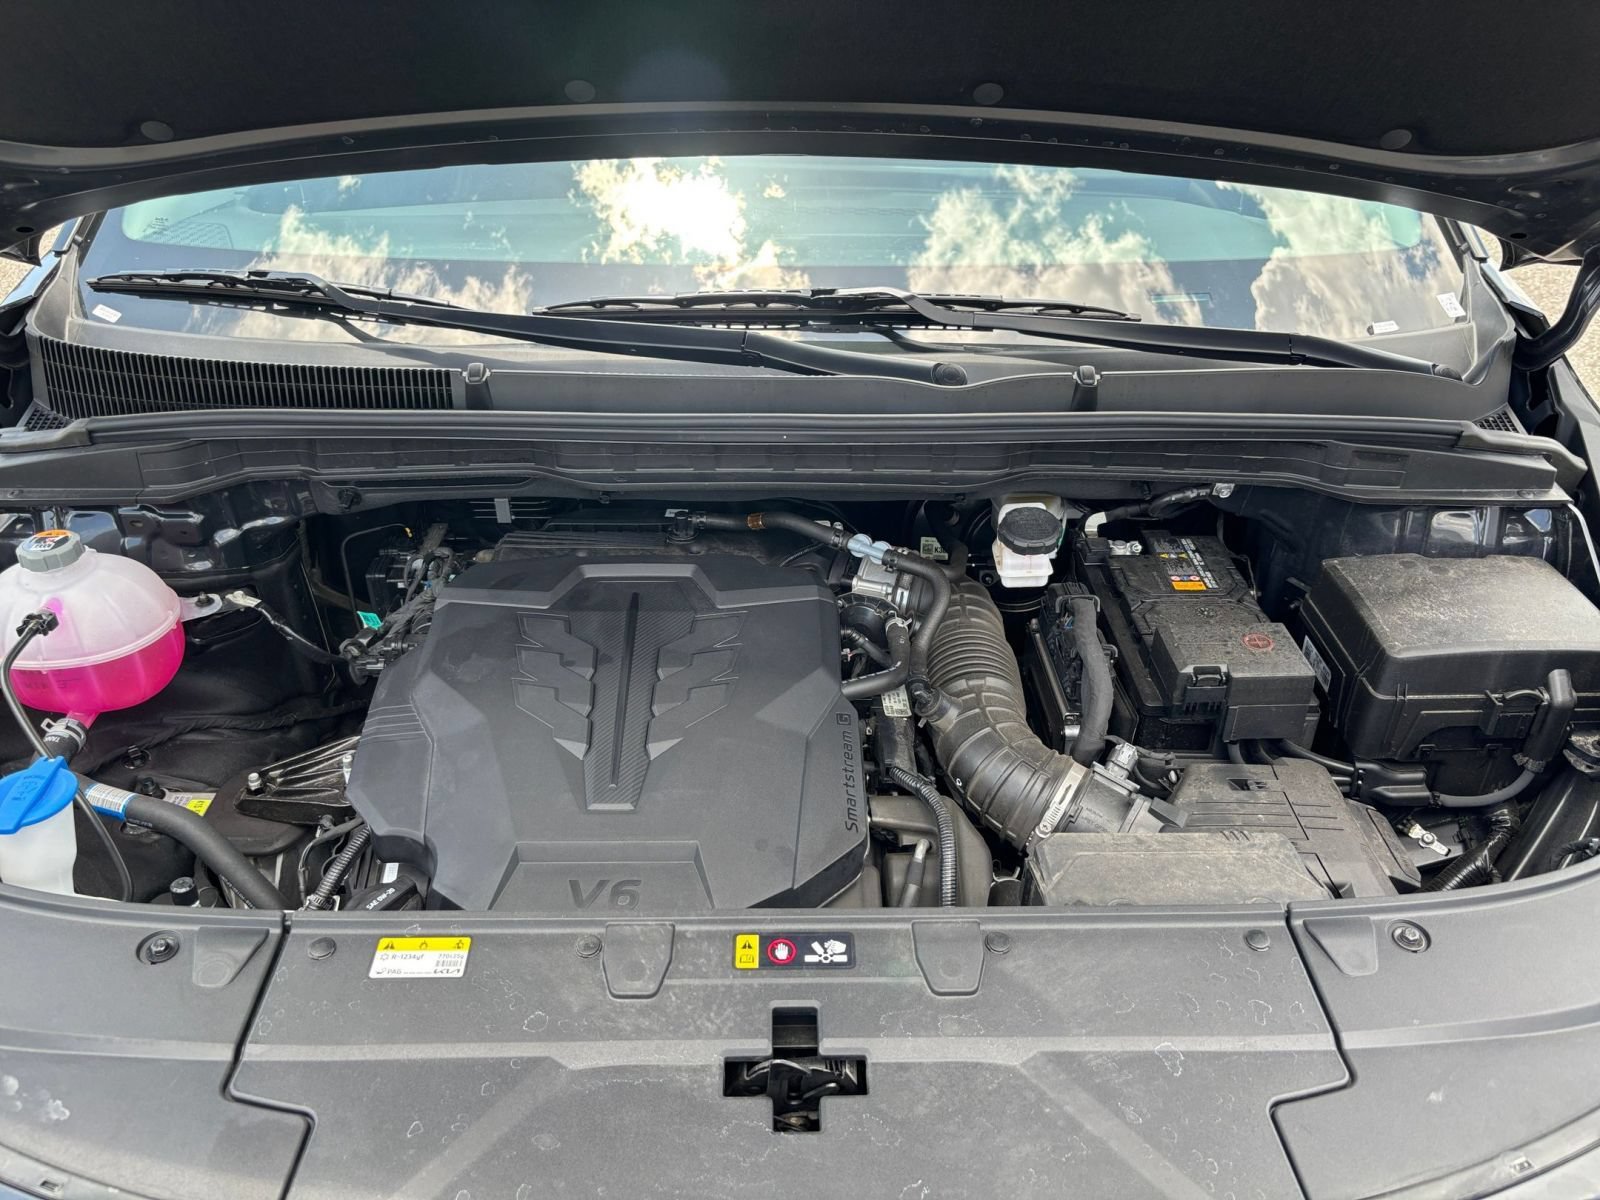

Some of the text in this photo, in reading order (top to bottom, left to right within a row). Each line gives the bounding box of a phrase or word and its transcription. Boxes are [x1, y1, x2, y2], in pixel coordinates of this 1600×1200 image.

[842, 730, 859, 833] Smartstream
[568, 879, 642, 909] V6
[366, 899, 380, 910] SAE
[391, 953, 424, 961] R-1234yf
